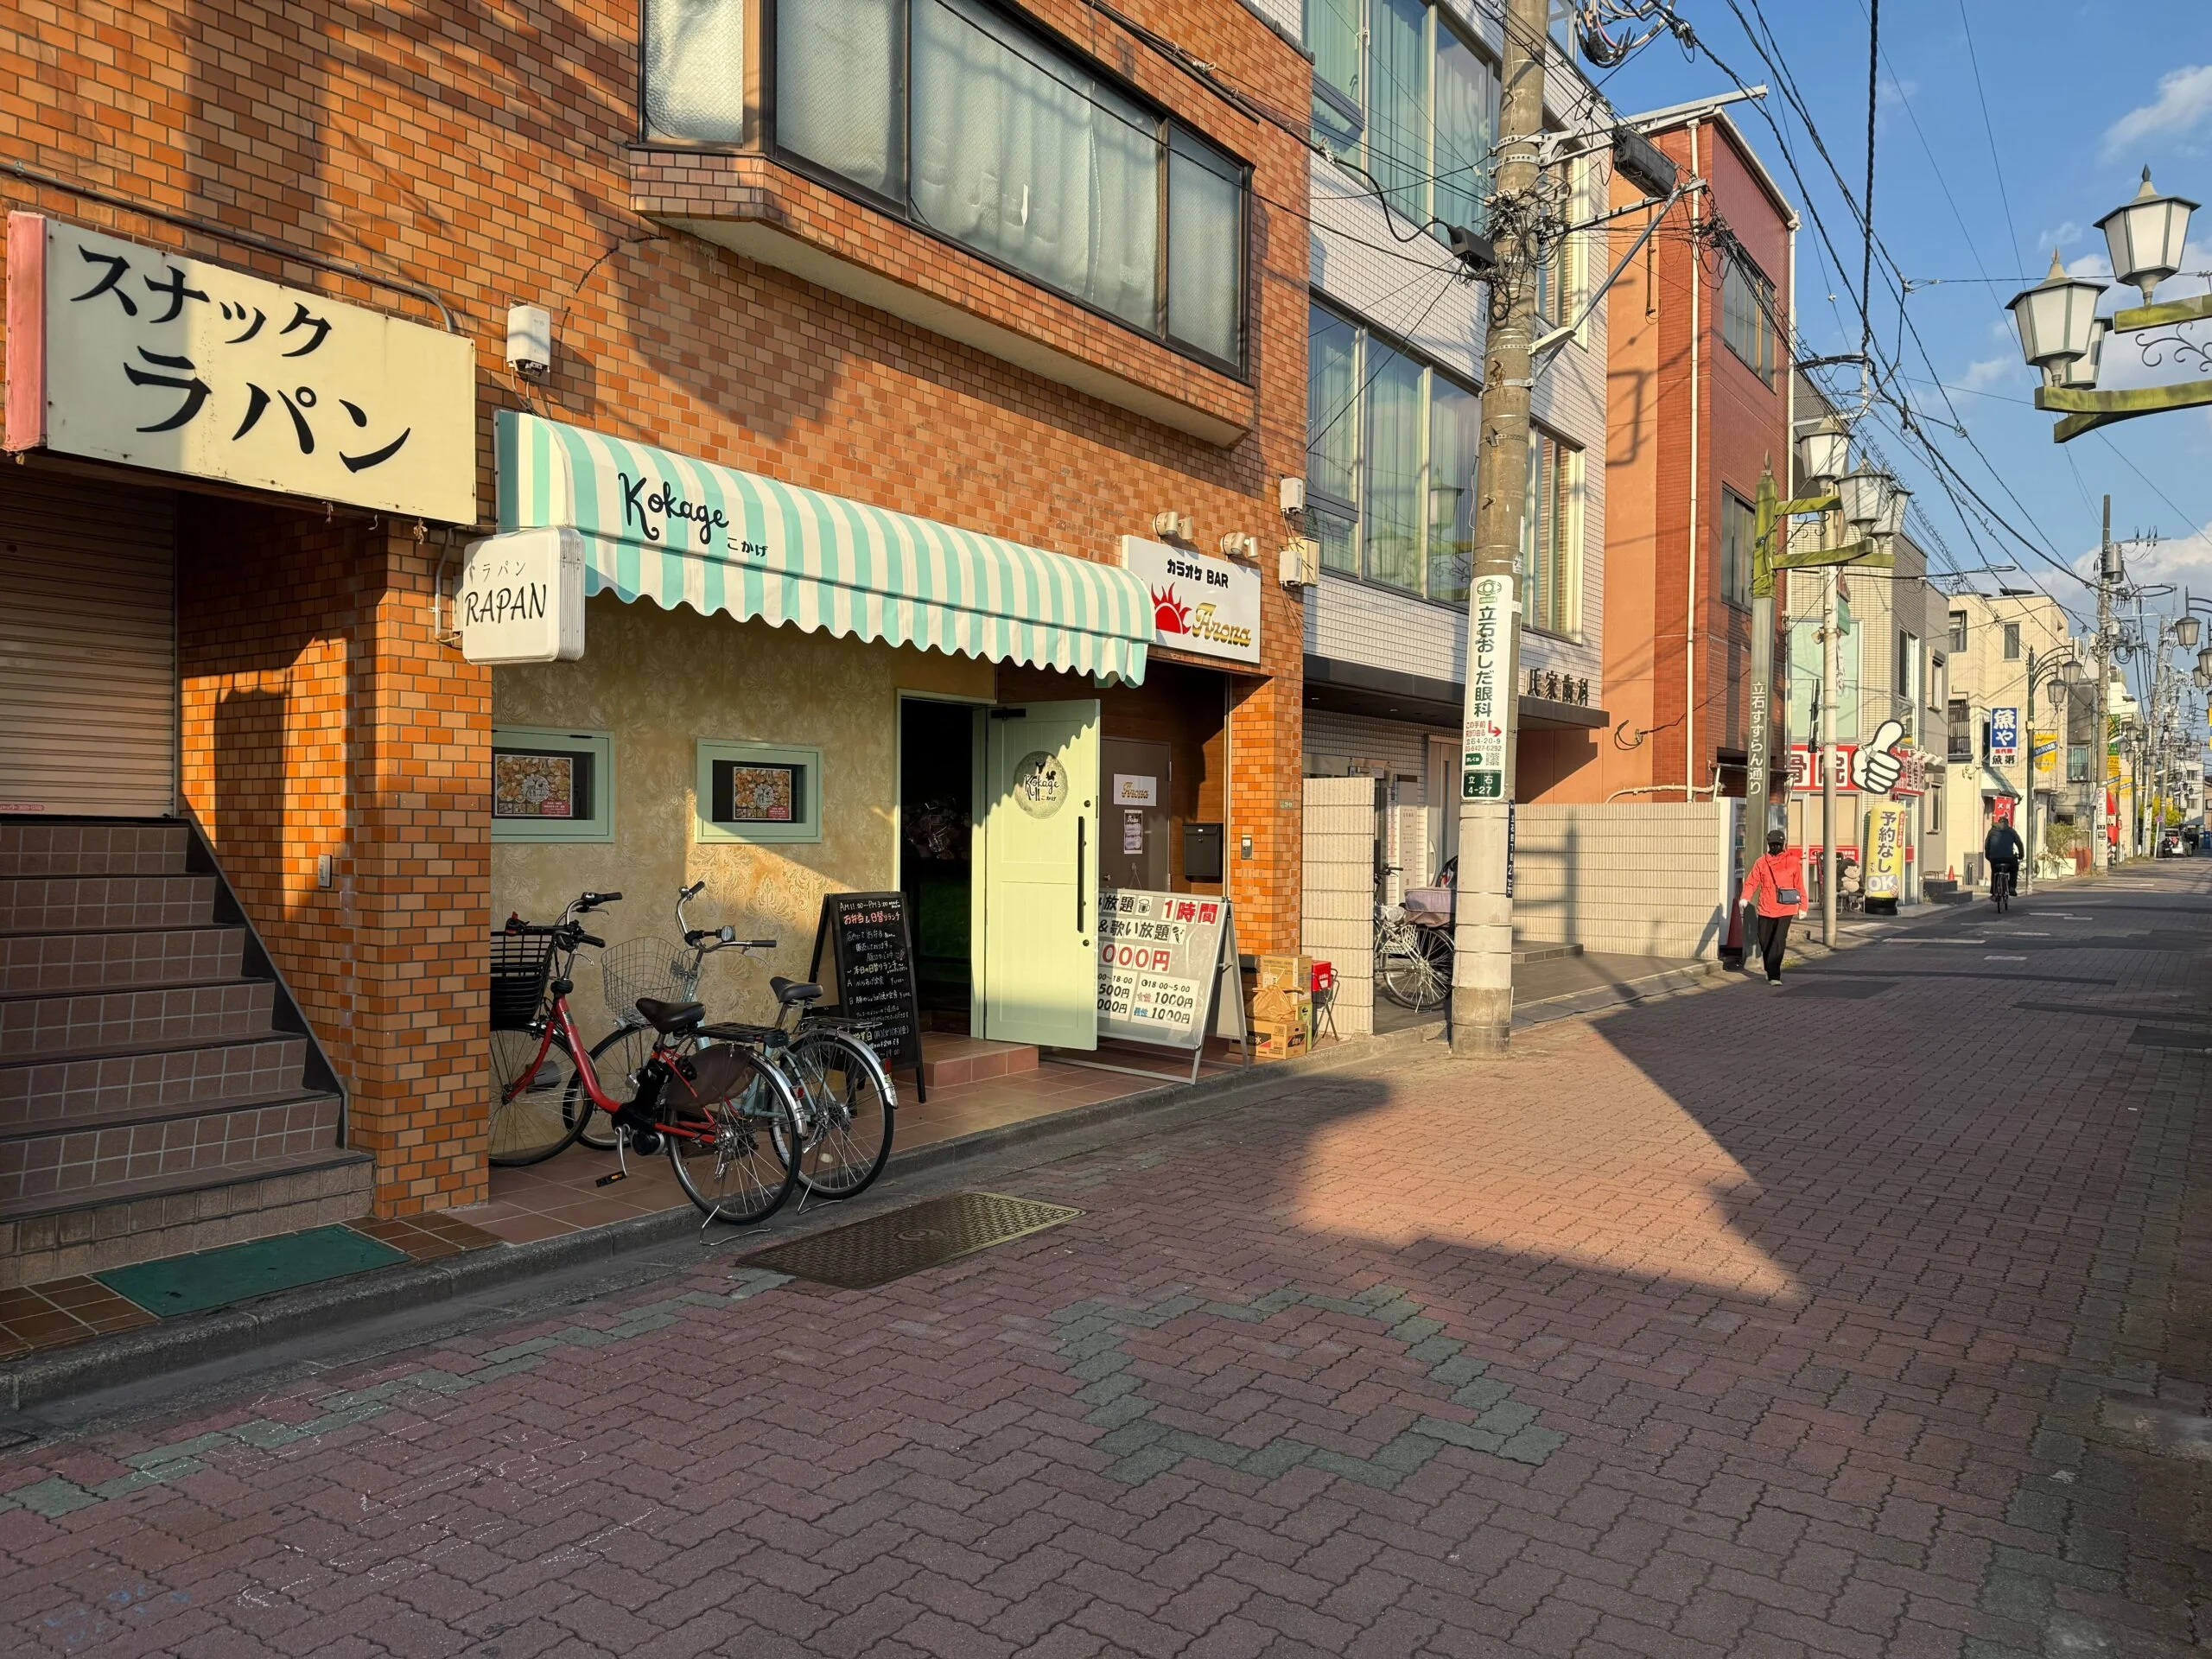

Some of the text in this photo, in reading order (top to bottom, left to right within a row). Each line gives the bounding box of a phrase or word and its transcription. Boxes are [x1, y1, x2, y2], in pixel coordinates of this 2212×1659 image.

[70, 245, 332, 357] スナック
[124, 346, 410, 473] ラパン
[618, 473, 729, 544] Kokage
[727, 537, 768, 557] こかげ
[482, 561, 525, 582] ラパン
[1167, 558, 1229, 588] カラオケ BAR
[465, 582, 547, 626] RAPAN
[1473, 606, 1497, 718] 立石おしだ眼科
[1749, 681, 1766, 795] 立石すずらん通り
[1993, 709, 2016, 746] 魚や
[1023, 774, 1059, 795] Kokage
[1468, 775, 1494, 785] 立石
[1876, 810, 1897, 874] 予約なし
[1867, 875, 1899, 893] OK
[1098, 894, 1219, 925] 放題 1時間
[1098, 918, 1171, 942] &歌い放題
